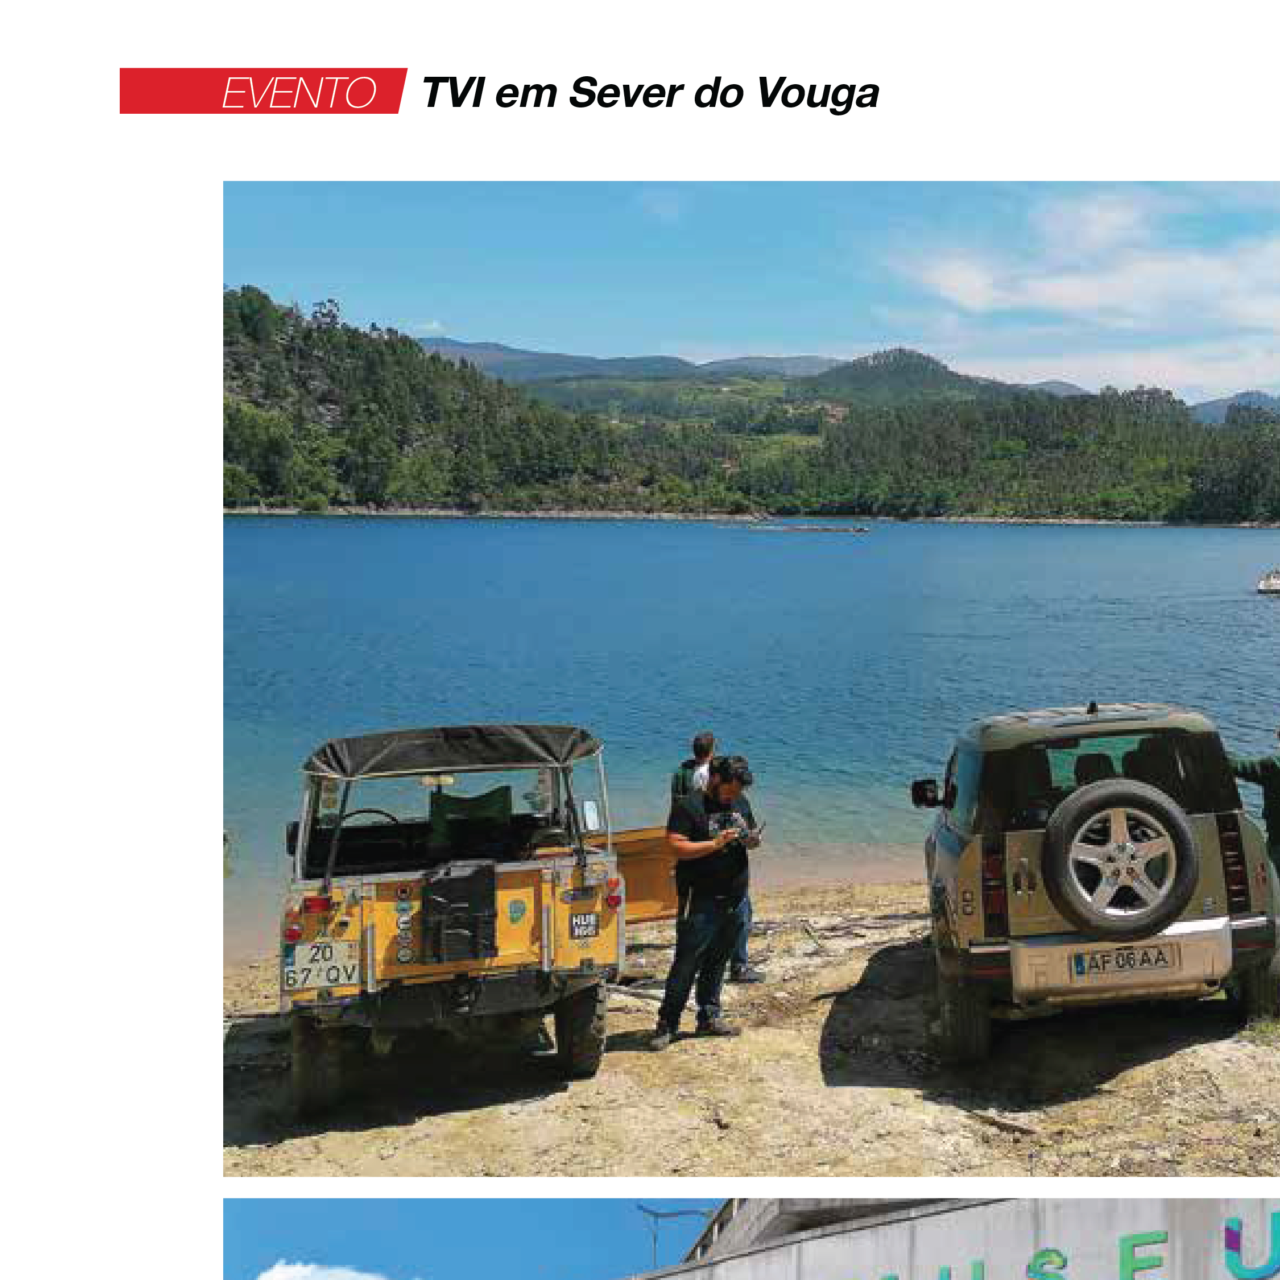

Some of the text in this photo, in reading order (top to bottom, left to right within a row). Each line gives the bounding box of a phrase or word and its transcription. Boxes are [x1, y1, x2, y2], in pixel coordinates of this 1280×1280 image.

[223, 77, 376, 108] EVENTO
[423, 76, 879, 116] TVI em Sever do Vouga
[310, 945, 333, 964] 20
[1089, 954, 1111, 971] AF
[1139, 949, 1169, 967] AA
